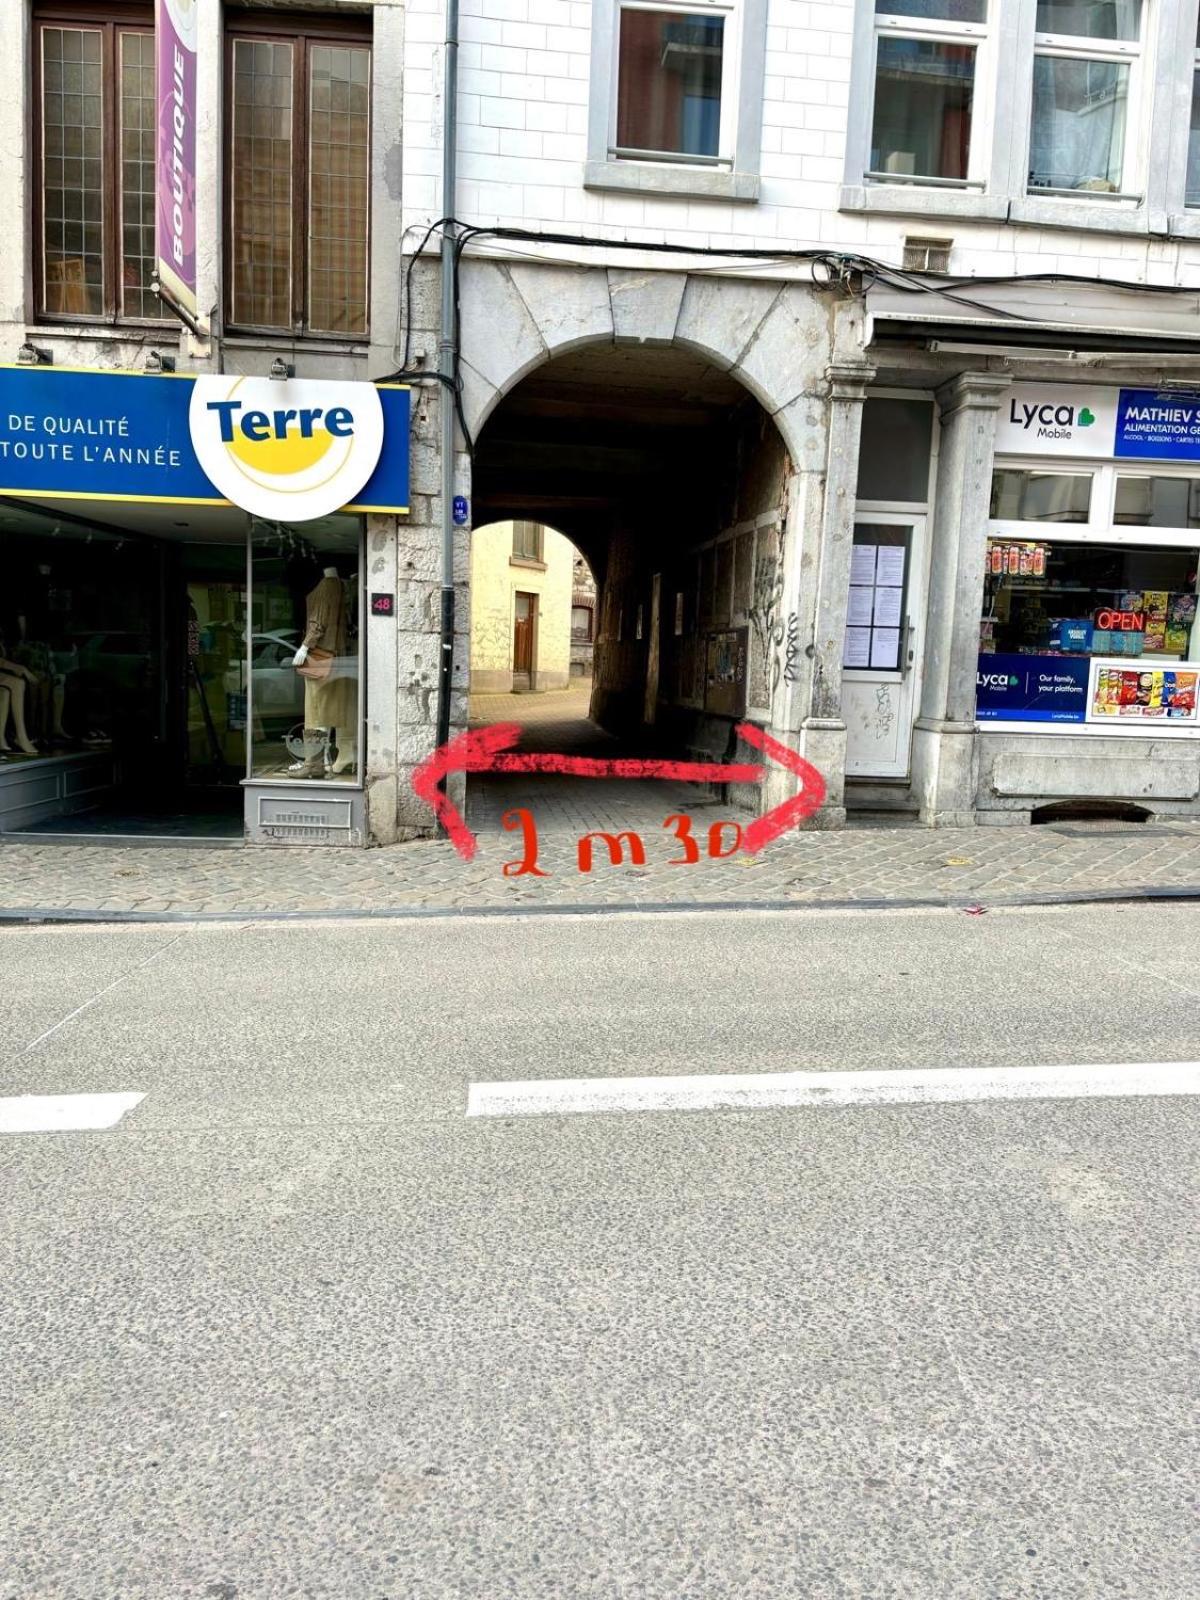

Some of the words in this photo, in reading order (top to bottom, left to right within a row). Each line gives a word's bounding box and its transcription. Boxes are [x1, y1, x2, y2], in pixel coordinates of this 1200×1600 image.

[173, 44, 184, 266] BOUTIQUE
[206, 400, 354, 442] Terre
[1010, 398, 1074, 429] Lyca
[1125, 406, 1193, 423] MATHIEV
[9, 414, 36, 432] DE
[43, 416, 129, 437] QUALITÉ
[1037, 427, 1072, 439] Mobile
[1124, 423, 1188, 434] ALIMENTATION
[0, 441, 74, 461] TOUTE
[84, 446, 181, 467] L'ANNÉE
[374, 598, 390, 610] 48
[1098, 612, 1144, 630] OPEN
[976, 671, 1008, 687] Lyca
[1039, 674, 1052, 682] Our
[1039, 685, 1054, 693] your
[1055, 686, 1083, 694] platform
